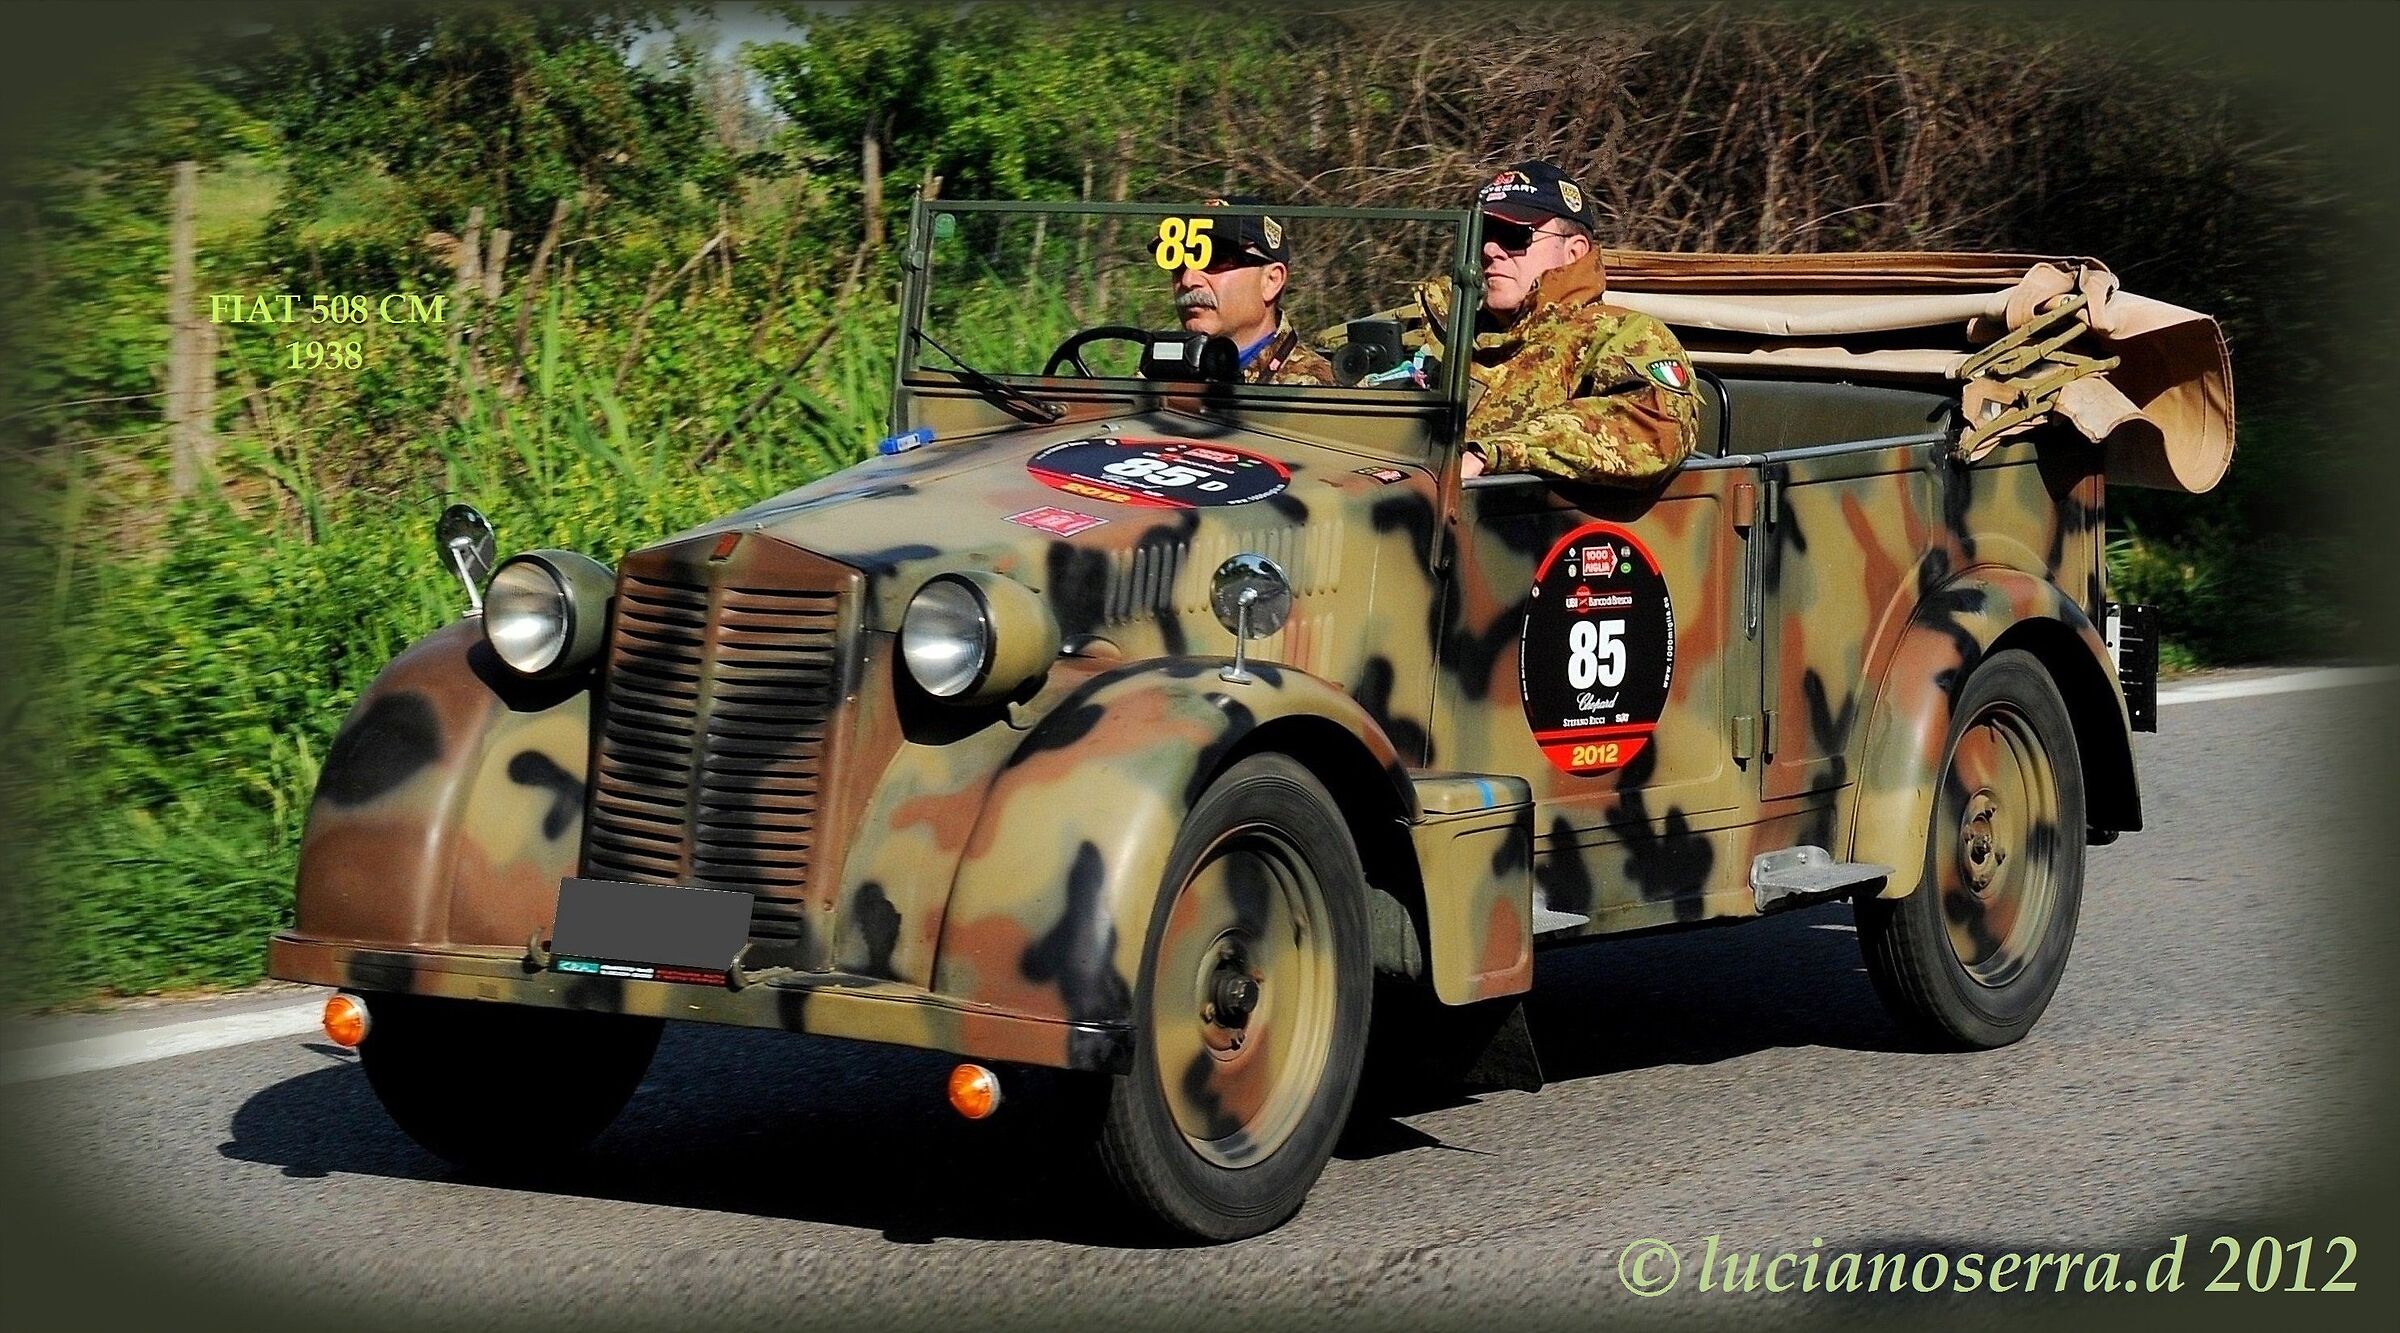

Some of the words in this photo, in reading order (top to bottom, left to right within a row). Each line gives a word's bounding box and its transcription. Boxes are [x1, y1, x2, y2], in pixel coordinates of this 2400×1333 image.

[1156, 217, 1213, 270] 85
[1103, 458, 1211, 487] 85
[1197, 481, 1229, 492] D
[1059, 482, 1133, 503] 2012
[1586, 550, 1608, 561] 1000
[1568, 619, 1627, 689] 85
[1577, 692, 1619, 712] Chopard
[1571, 743, 1619, 766] 2012
